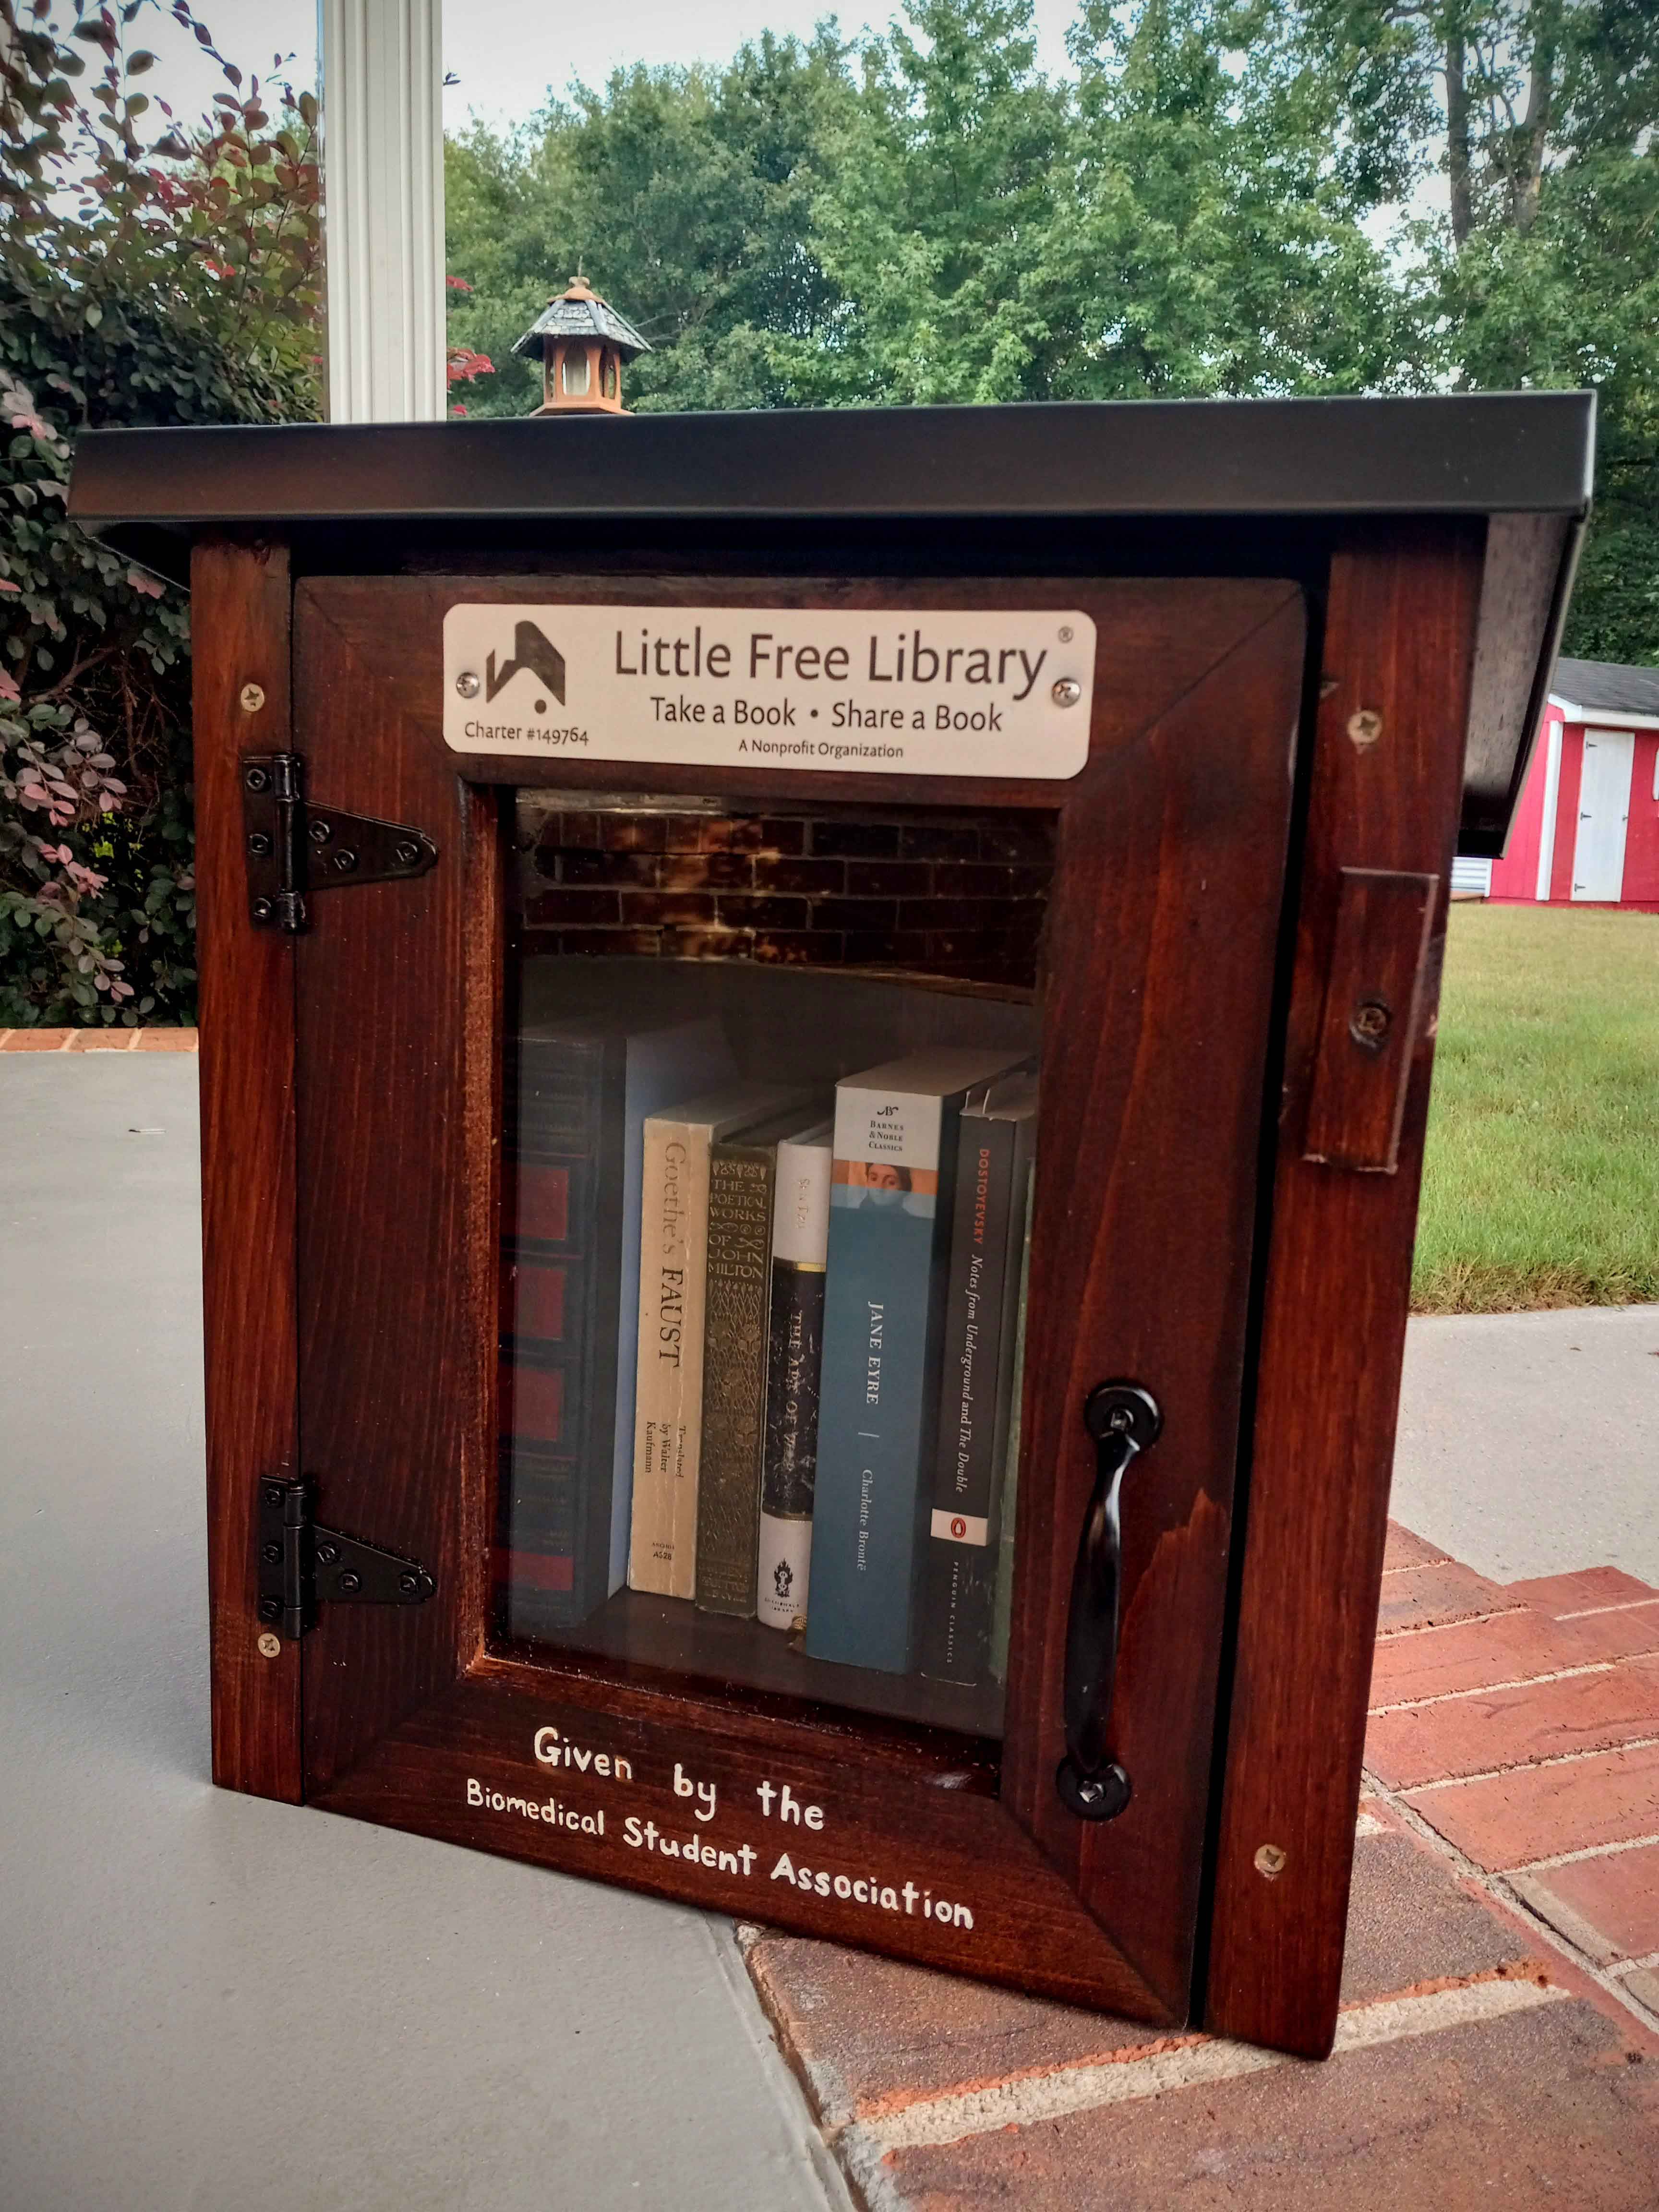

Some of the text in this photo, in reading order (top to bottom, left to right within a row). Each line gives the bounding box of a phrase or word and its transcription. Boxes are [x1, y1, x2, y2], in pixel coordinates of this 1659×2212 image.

[615, 626, 731, 677] Little
[750, 633, 850, 681] Free
[868, 630, 1047, 701] Library
[465, 720, 589, 746] Charter #149764
[650, 694, 706, 723] Take
[712, 703, 725, 724] a
[733, 697, 796, 727] Book
[831, 699, 904, 729] Share
[912, 709, 926, 731] a
[935, 702, 1003, 732] Book
[738, 739, 904, 759] A Nonprofit Organization
[869, 1130, 875, 1139] &
[870, 1120, 904, 1130] BARNES
[711, 1178, 745, 1191] THE
[709, 1206, 766, 1222] WORKS
[659, 1142, 686, 1368] Goethe's FAUST
[708, 1248, 764, 1264] JOHN
[709, 1234, 732, 1246] OF
[708, 1261, 763, 1279] MILTON
[956, 1148, 991, 1493] DOSTOYEVSKY Notes from Underground and The Double
[866, 1300, 884, 1405] JANE EYRE
[645, 1420, 656, 1473] Kaufmann
[659, 1423, 671, 1473] by Walter
[856, 1469, 873, 1571] Charlotte Brontë
[947, 1561, 959, 1663] PENGUIN CLASSICS
[533, 1725, 825, 1832] Given by the
[466, 1777, 974, 1931] Biomedical Student Association
